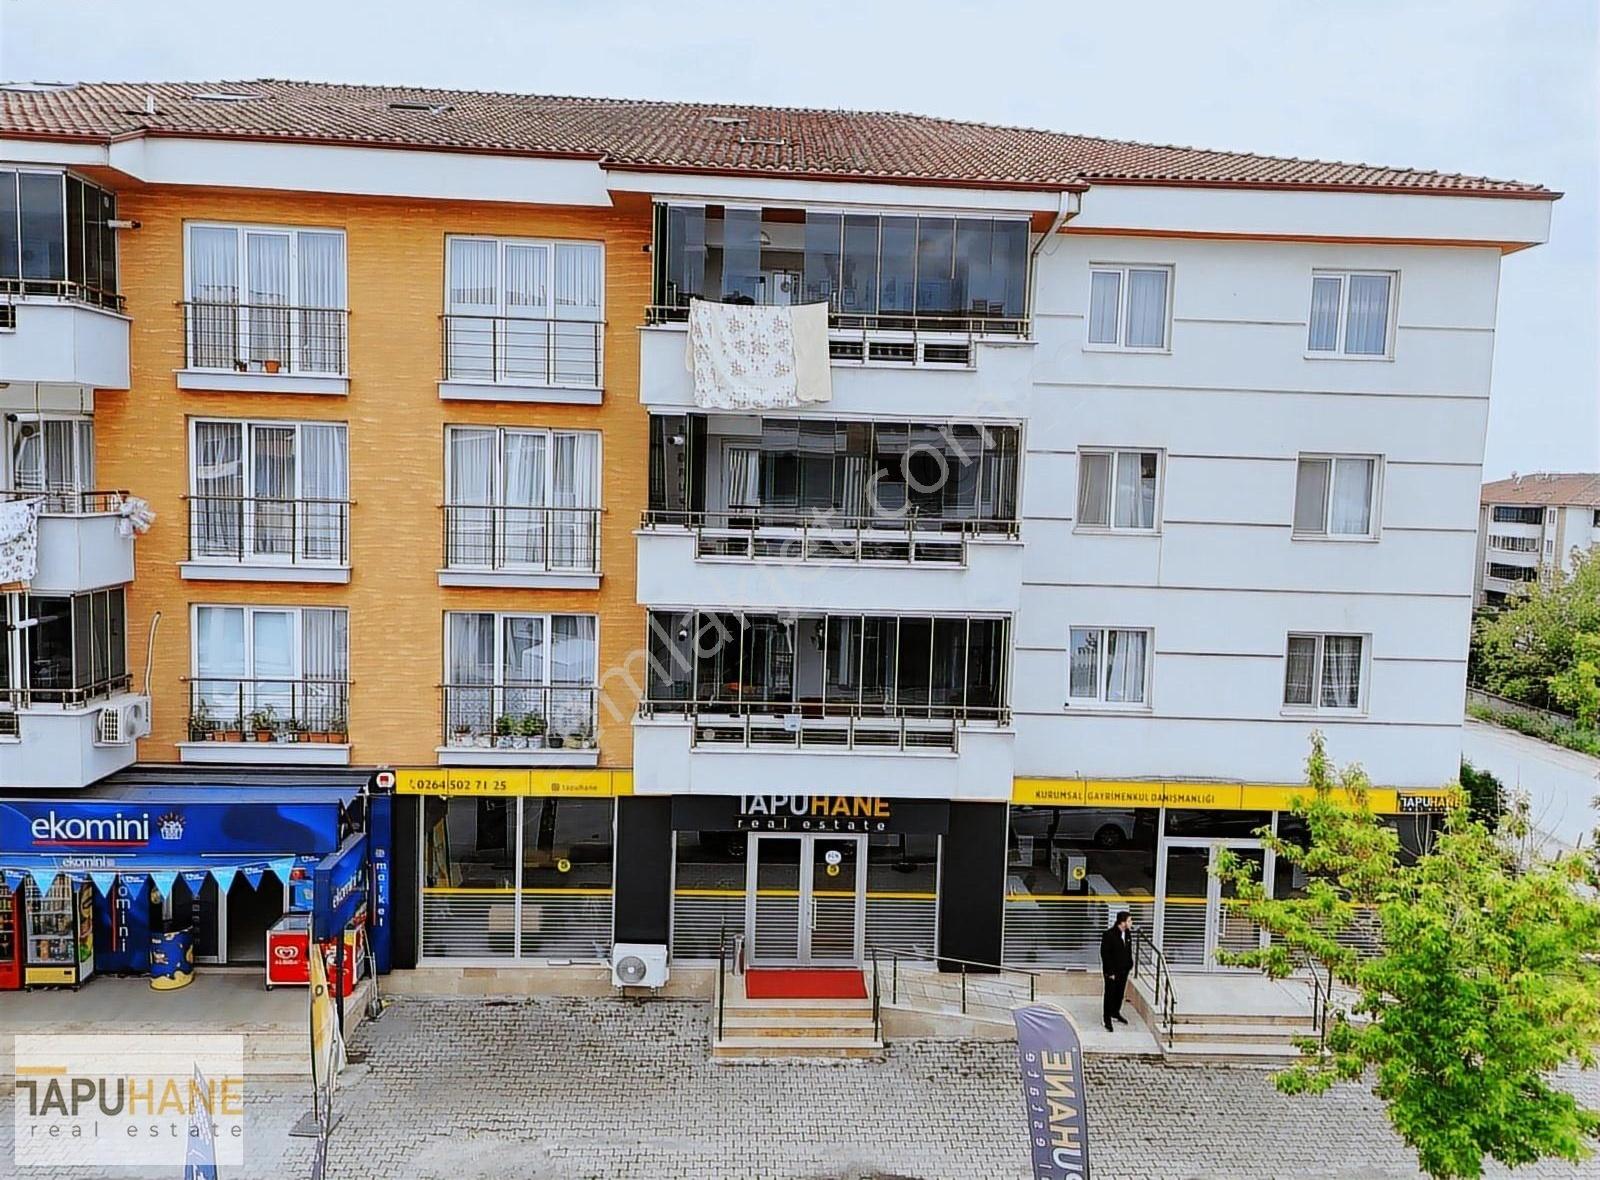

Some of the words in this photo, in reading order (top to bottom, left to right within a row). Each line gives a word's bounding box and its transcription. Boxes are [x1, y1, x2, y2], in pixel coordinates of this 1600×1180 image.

[416, 780, 446, 791] 0264
[449, 780, 471, 791] 502
[475, 780, 487, 791] 71
[493, 781, 507, 791] 25
[1035, 790, 1082, 800] KURUMSAL
[31, 810, 149, 840] ekomini
[737, 818, 787, 830] real
[802, 819, 886, 831] estate
[62, 855, 106, 869] ekomini
